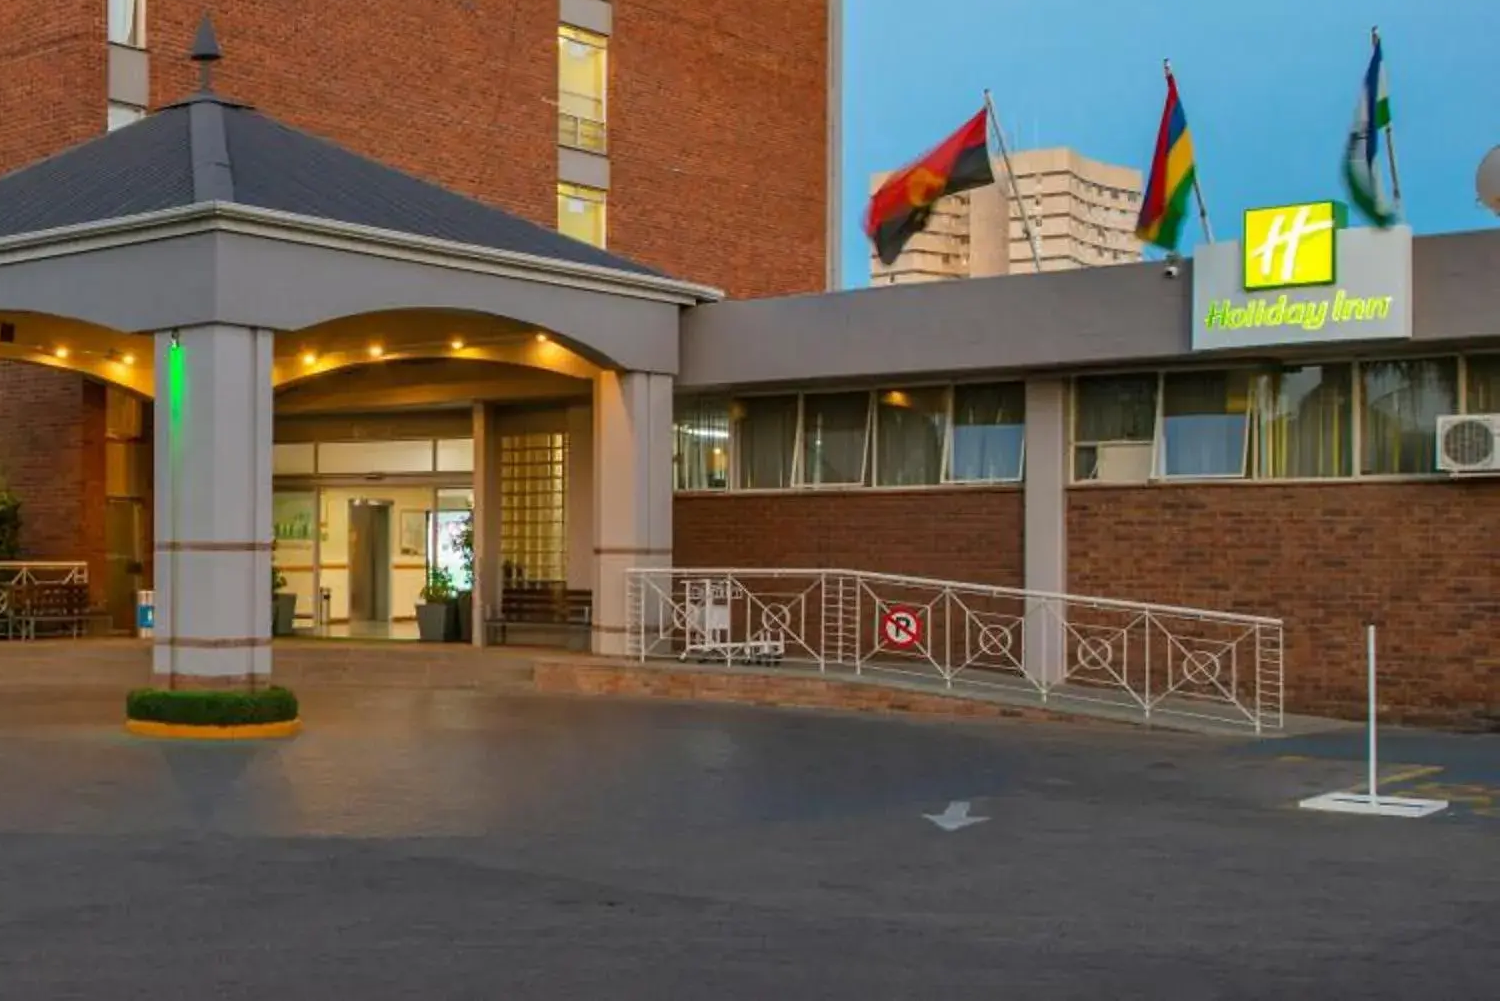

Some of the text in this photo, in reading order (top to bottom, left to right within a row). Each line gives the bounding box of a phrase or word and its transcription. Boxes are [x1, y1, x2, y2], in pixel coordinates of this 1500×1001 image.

[1252, 205, 1335, 283] H
[1205, 290, 1392, 330] Holiday Inn
[895, 616, 910, 638] P
